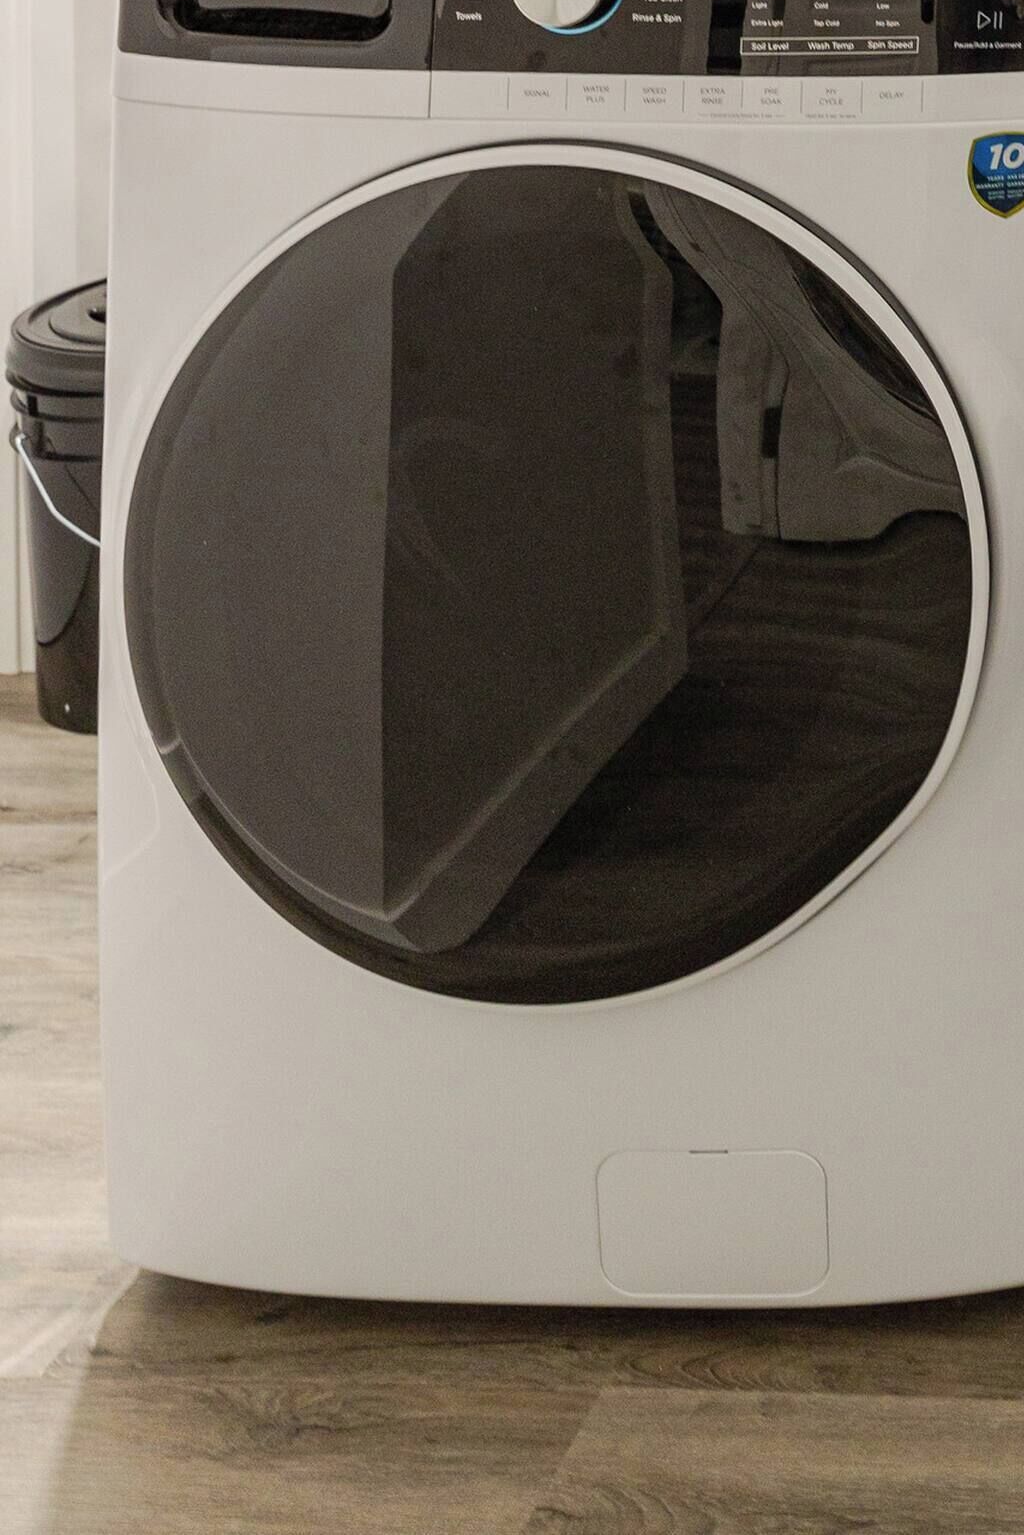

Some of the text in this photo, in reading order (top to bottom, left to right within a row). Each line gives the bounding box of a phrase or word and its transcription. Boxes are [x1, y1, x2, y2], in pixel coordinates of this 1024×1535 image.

[876, 2, 890, 10] Low
[456, 11, 482, 21] Towels
[632, 13, 682, 24] Rinse & Spin
[751, 42, 789, 51] Soil Level
[808, 42, 854, 52] Wash Temp
[867, 41, 913, 51] Spin Speed
[583, 85, 610, 93] WATER
[878, 91, 904, 100] DELAY
